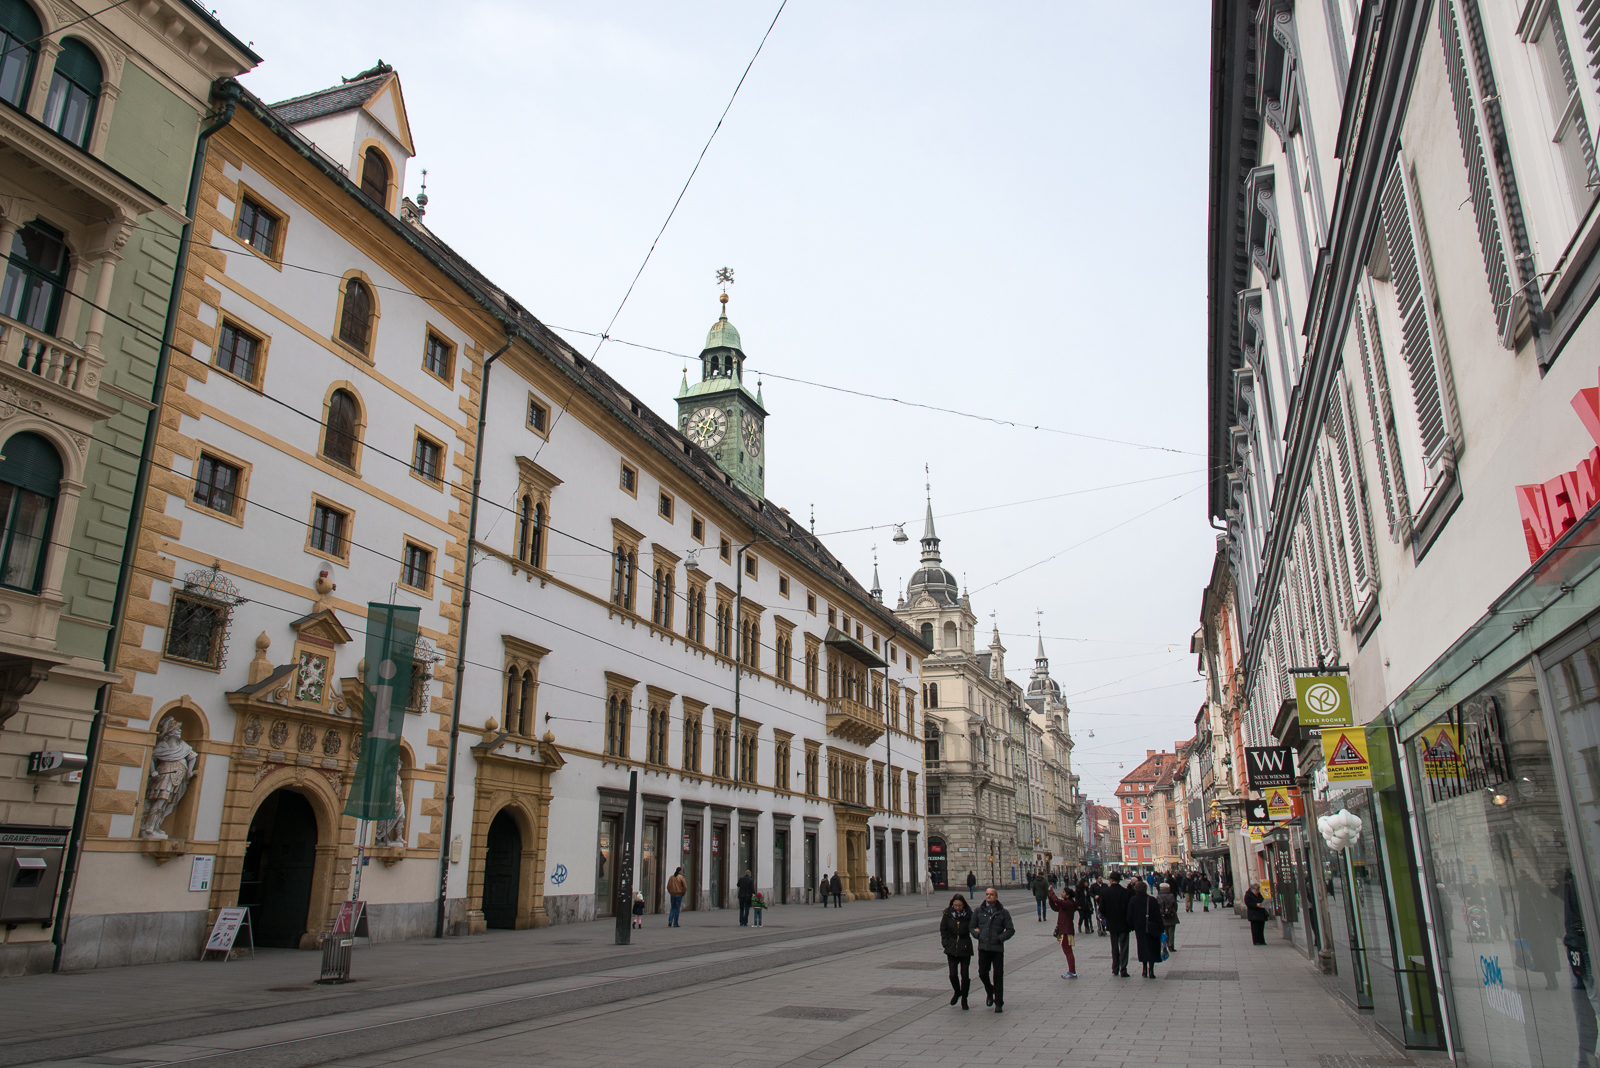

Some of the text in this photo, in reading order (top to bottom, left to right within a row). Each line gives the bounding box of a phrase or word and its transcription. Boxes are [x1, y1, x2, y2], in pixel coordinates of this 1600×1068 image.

[1196, 816, 1205, 842] HUMANIC
[2, 834, 61, 843] GRAWE Terminal
